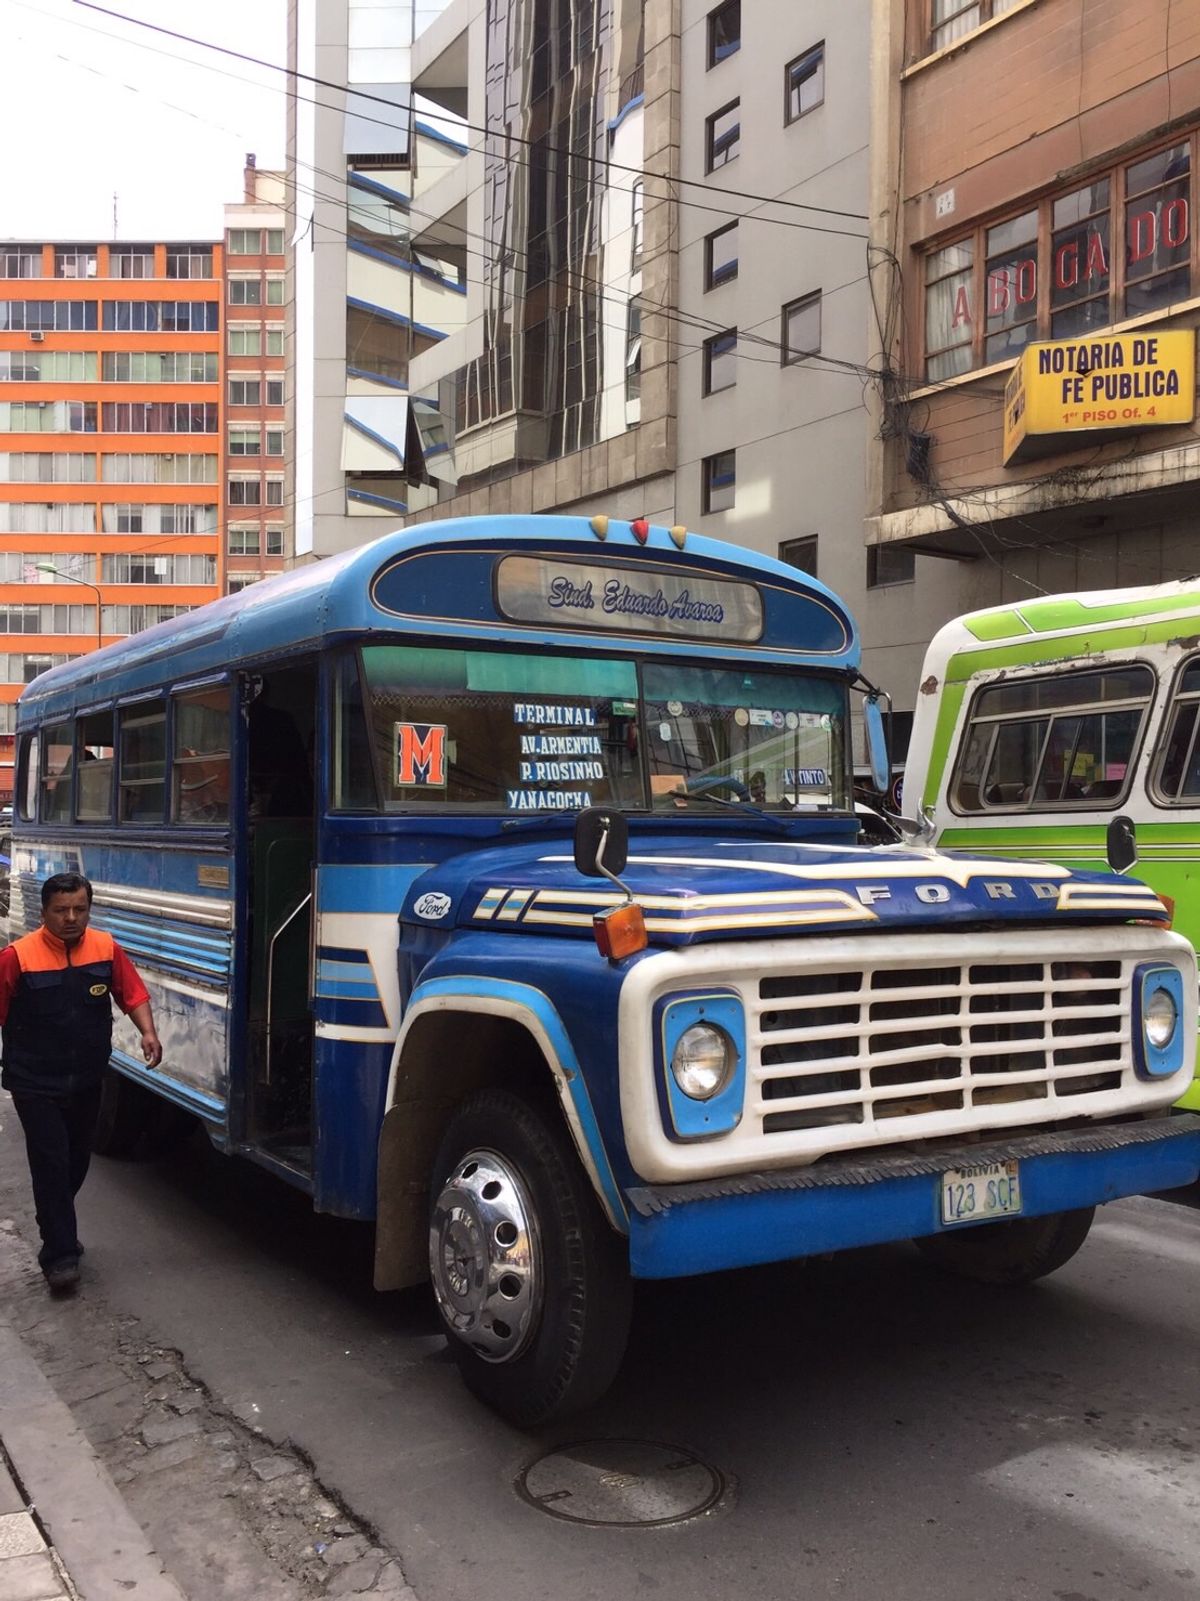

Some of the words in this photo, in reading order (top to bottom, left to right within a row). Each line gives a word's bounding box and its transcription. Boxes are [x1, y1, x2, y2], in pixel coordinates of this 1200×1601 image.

[952, 198, 1188, 328] ABOGADO
[1039, 342, 1124, 375] NOTARIA
[1133, 338, 1158, 366] DE
[1062, 378, 1084, 404] FE
[1092, 369, 1179, 402] PUBLICA
[1083, 409, 1117, 422] PISO
[1147, 406, 1157, 417] 4
[548, 576, 594, 609] Sind.
[602, 579, 668, 616] Eduardo
[668, 589, 723, 623] Avaroa
[515, 703, 595, 726] TERMINAL
[399, 725, 445, 785] M
[417, 893, 450, 916] Ford
[855, 882, 1061, 906] FORD
[960, 1165, 1000, 1179] BOLIVIA
